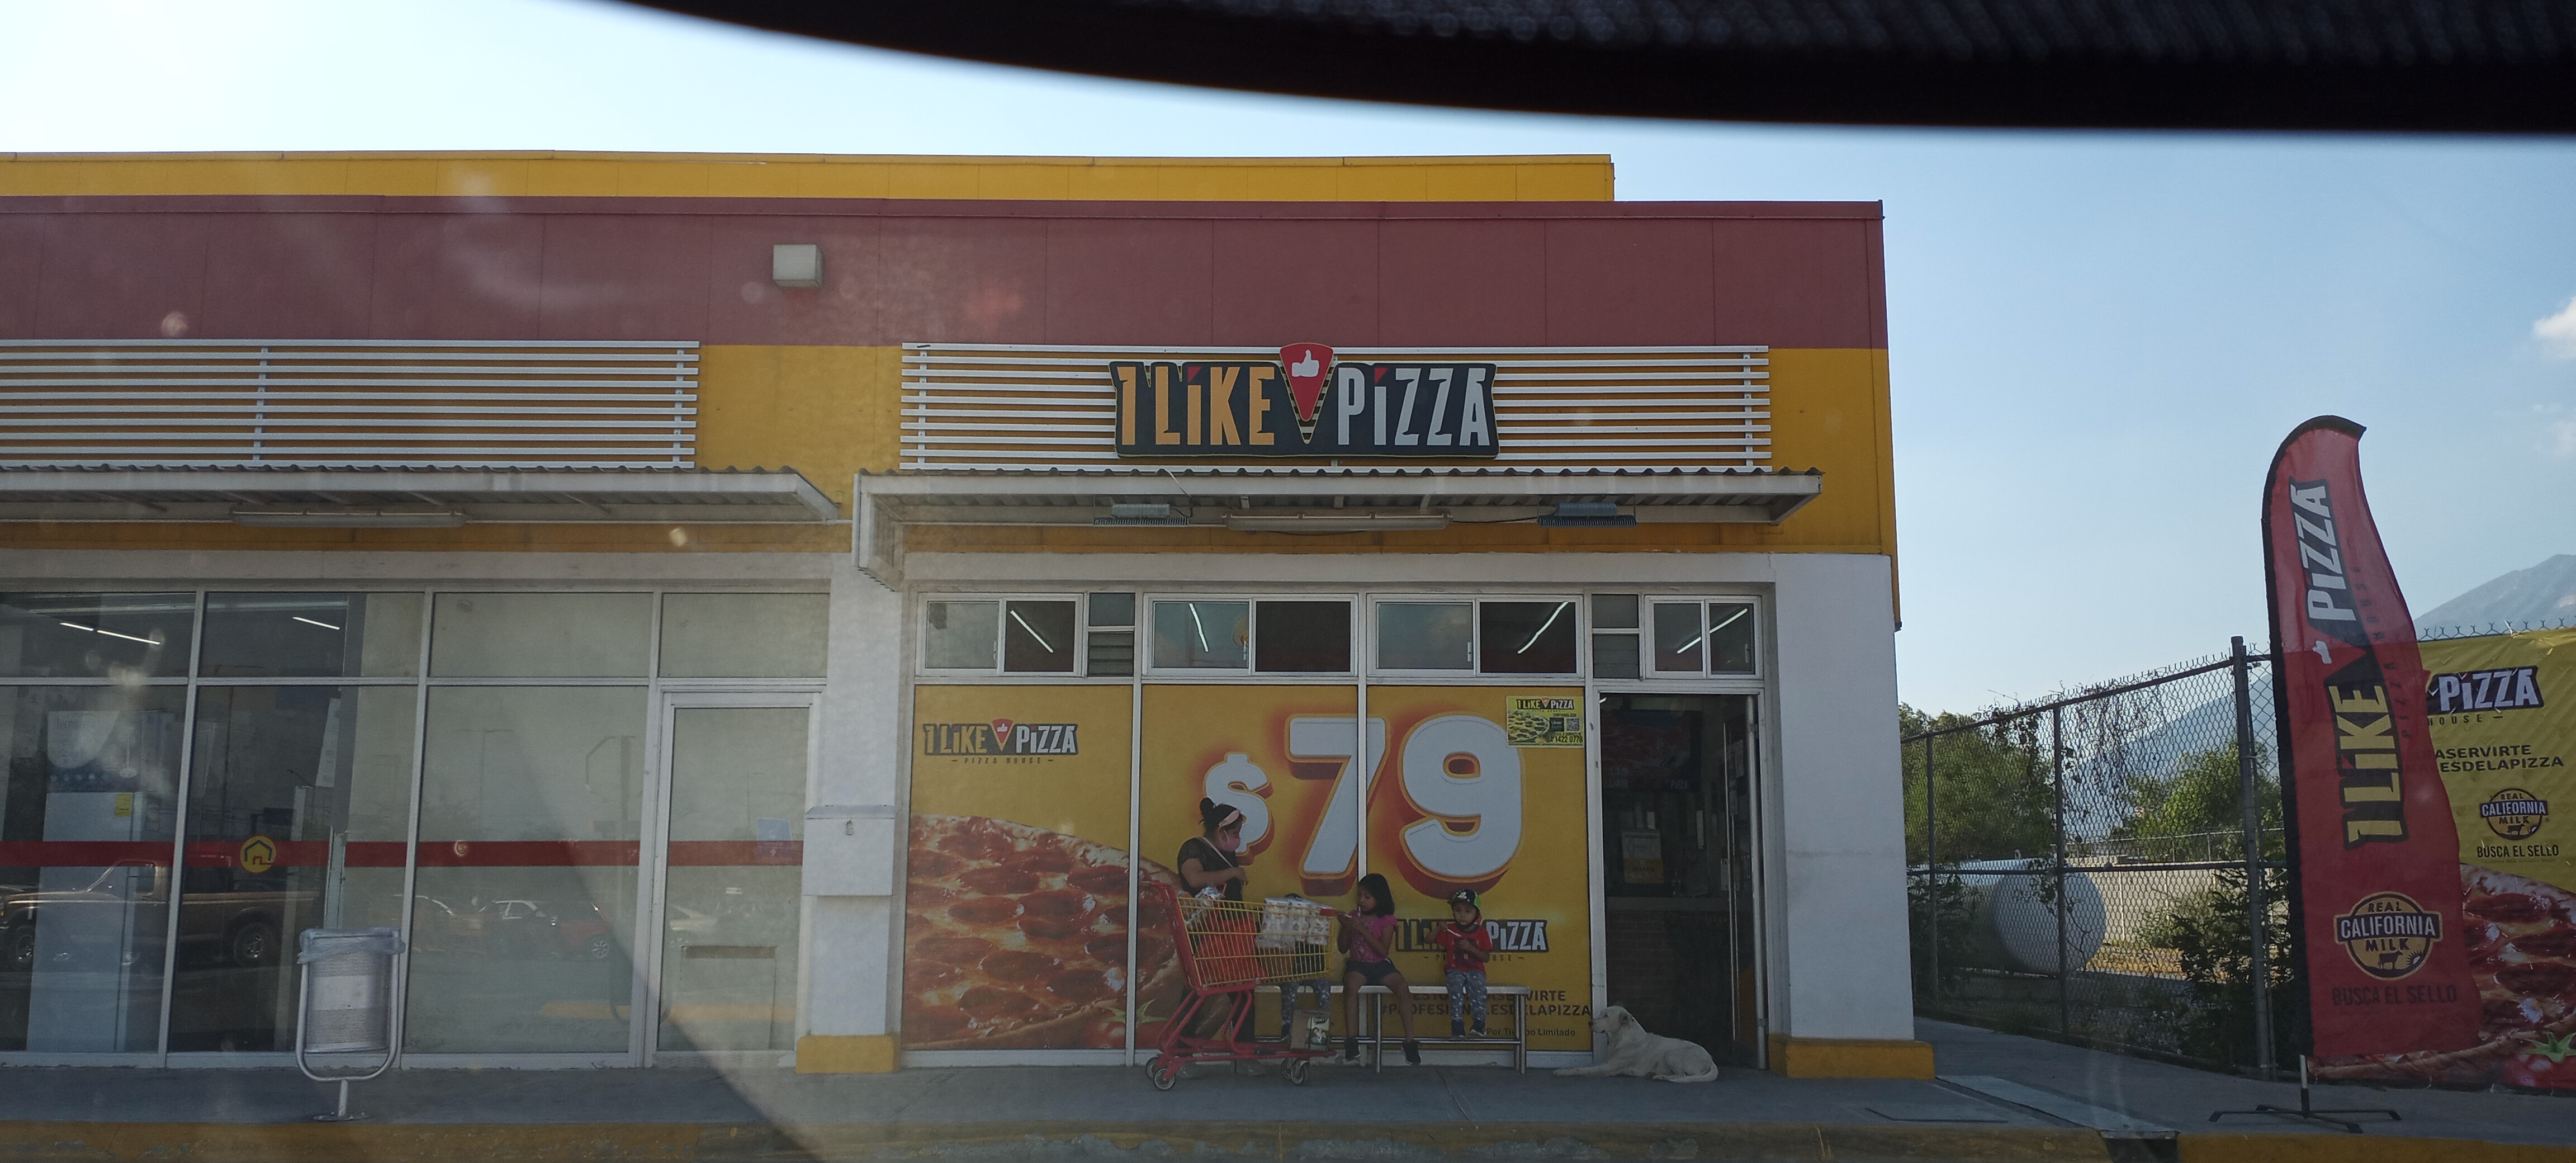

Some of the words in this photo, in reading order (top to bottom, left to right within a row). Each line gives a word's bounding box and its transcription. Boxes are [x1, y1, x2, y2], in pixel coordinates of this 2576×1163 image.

[1117, 367, 1136, 446] 1
[1517, 699, 1521, 709] 1
[923, 726, 935, 753] 1
[2501, 792, 2524, 801] REAL
[2482, 801, 2546, 817] CALIFORNIA
[2498, 815, 2530, 825] MILK
[2347, 820, 2403, 844] 1
[2477, 845, 2510, 858] BUSCA
[2513, 845, 2525, 857] EL
[2527, 844, 2559, 857] SELLO
[2367, 901, 2402, 913] REAL
[2340, 915, 2436, 940] CALIFORNIA
[2365, 937, 2410, 952] MILK
[2331, 986, 2380, 1006] BUSCA
[2385, 985, 2402, 1005] EL
[2406, 984, 2457, 1004] SELLO
